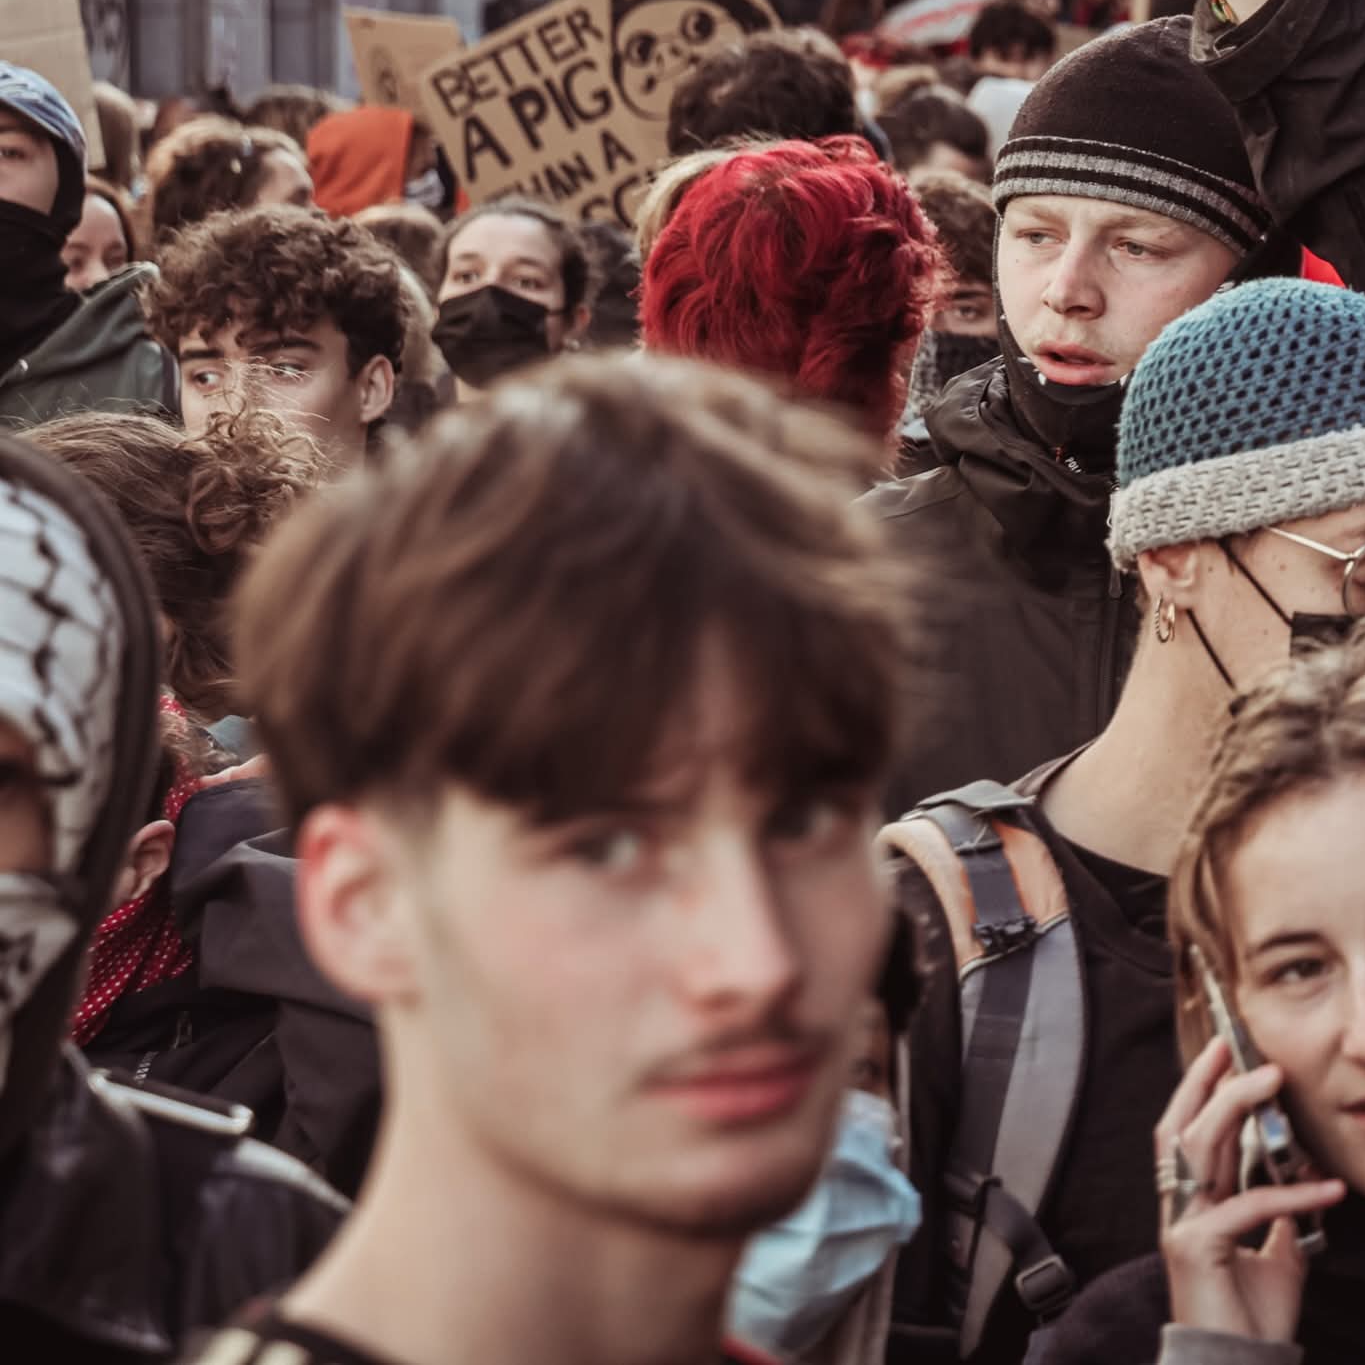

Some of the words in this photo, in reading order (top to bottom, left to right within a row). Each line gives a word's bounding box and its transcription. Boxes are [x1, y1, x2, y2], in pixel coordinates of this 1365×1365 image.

[430, 10, 604, 117] BETTER
[463, 116, 511, 183] A
[508, 62, 612, 151] PIG
[602, 129, 636, 172] A
